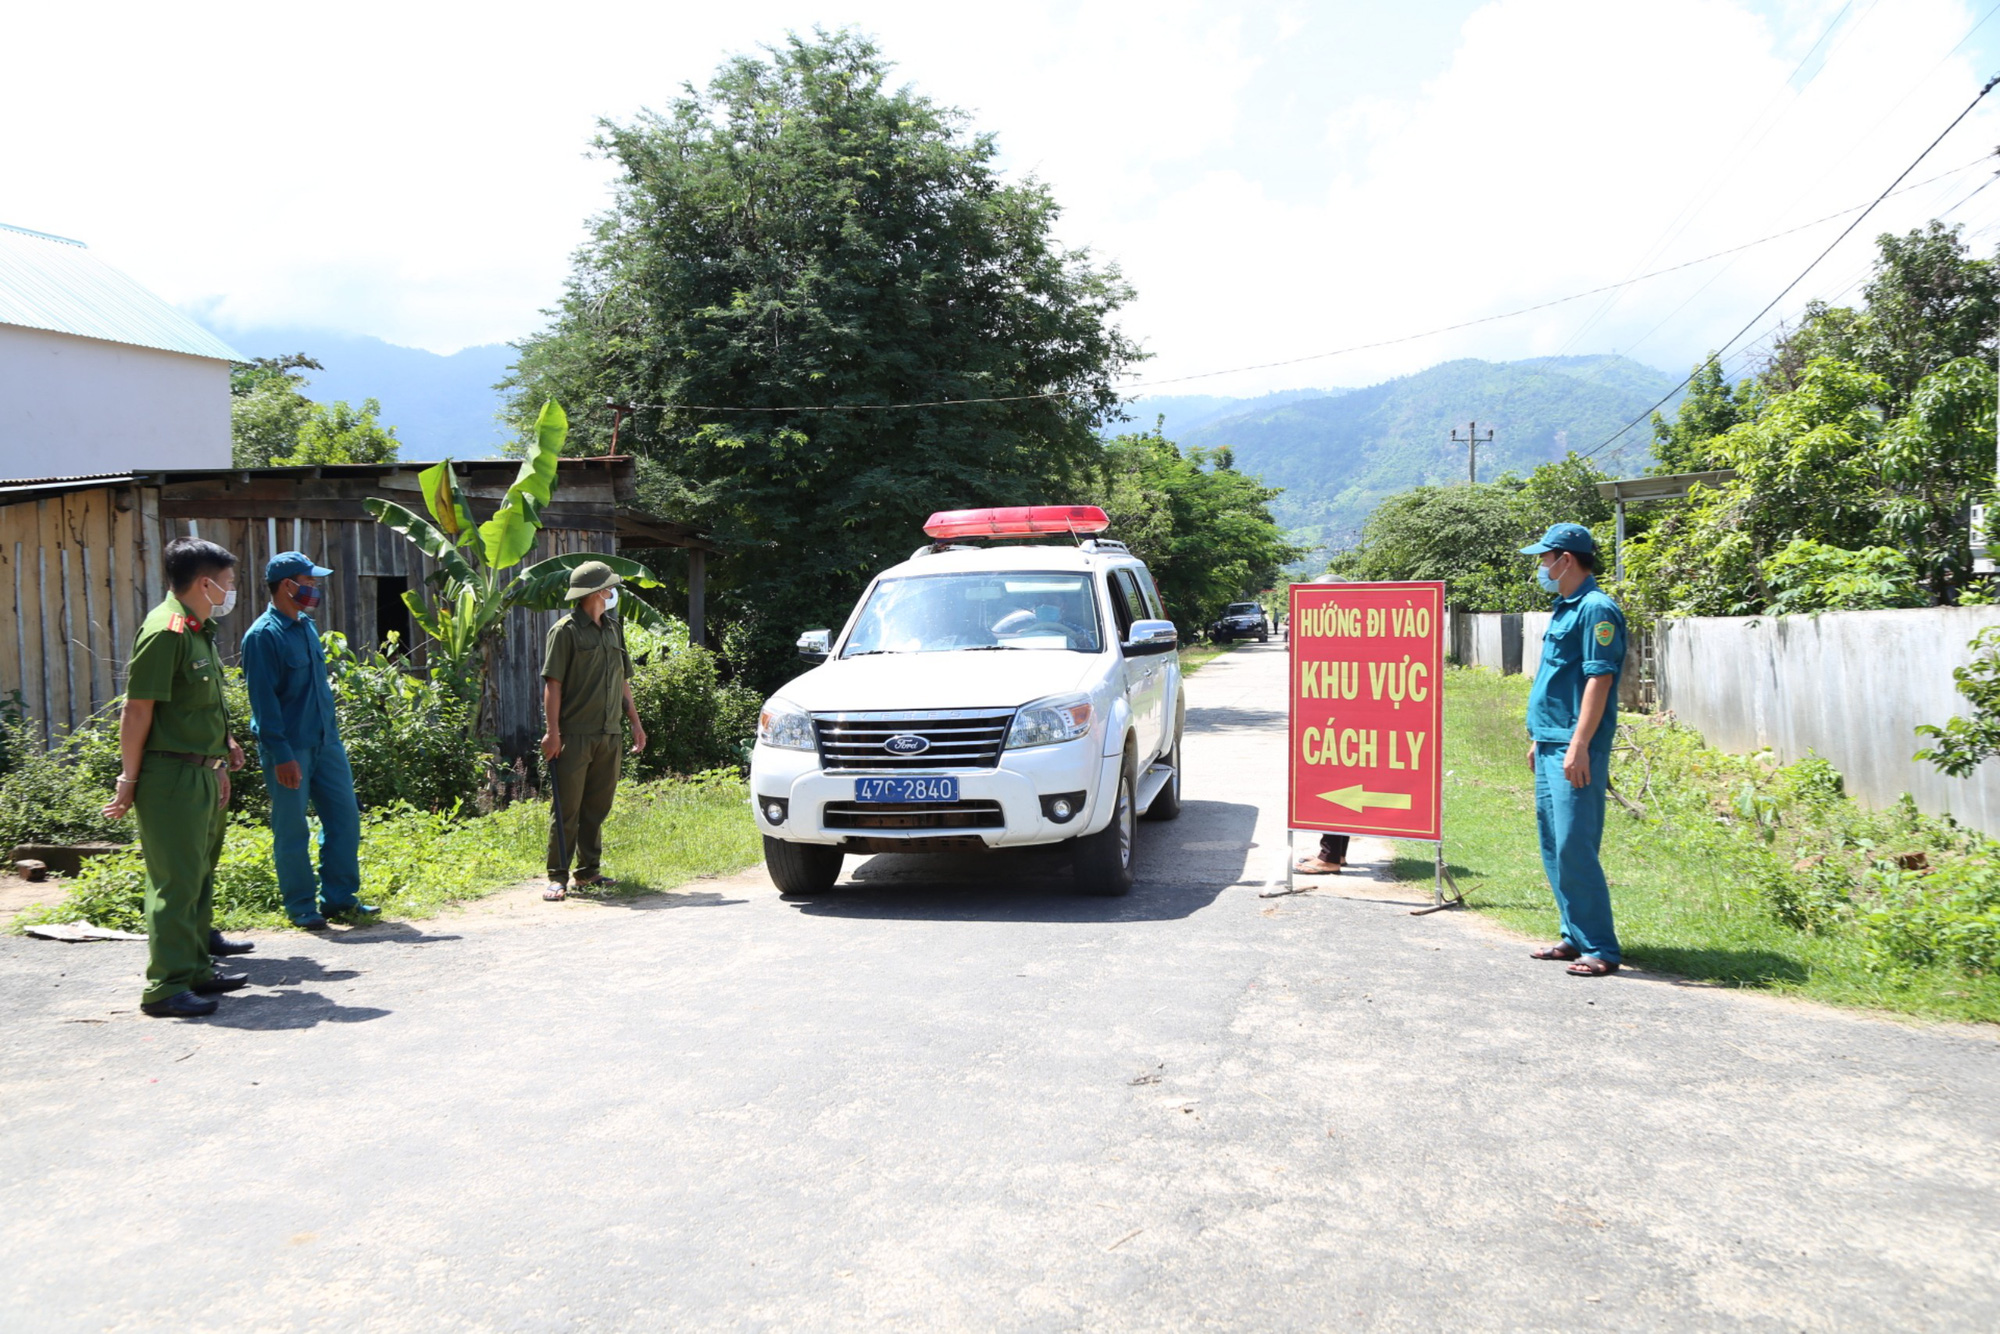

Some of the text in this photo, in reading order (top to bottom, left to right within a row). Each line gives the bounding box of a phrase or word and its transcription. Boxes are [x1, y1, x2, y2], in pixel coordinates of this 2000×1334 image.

[1300, 600, 1430, 638] HƯỚNG ĐI VÀO
[1301, 654, 1428, 710] KHU VỰC
[837, 709, 985, 722] VEREST
[894, 738, 919, 750] Ford
[1302, 717, 1426, 770] CÁCH LY
[861, 779, 952, 800] 47C-2840
